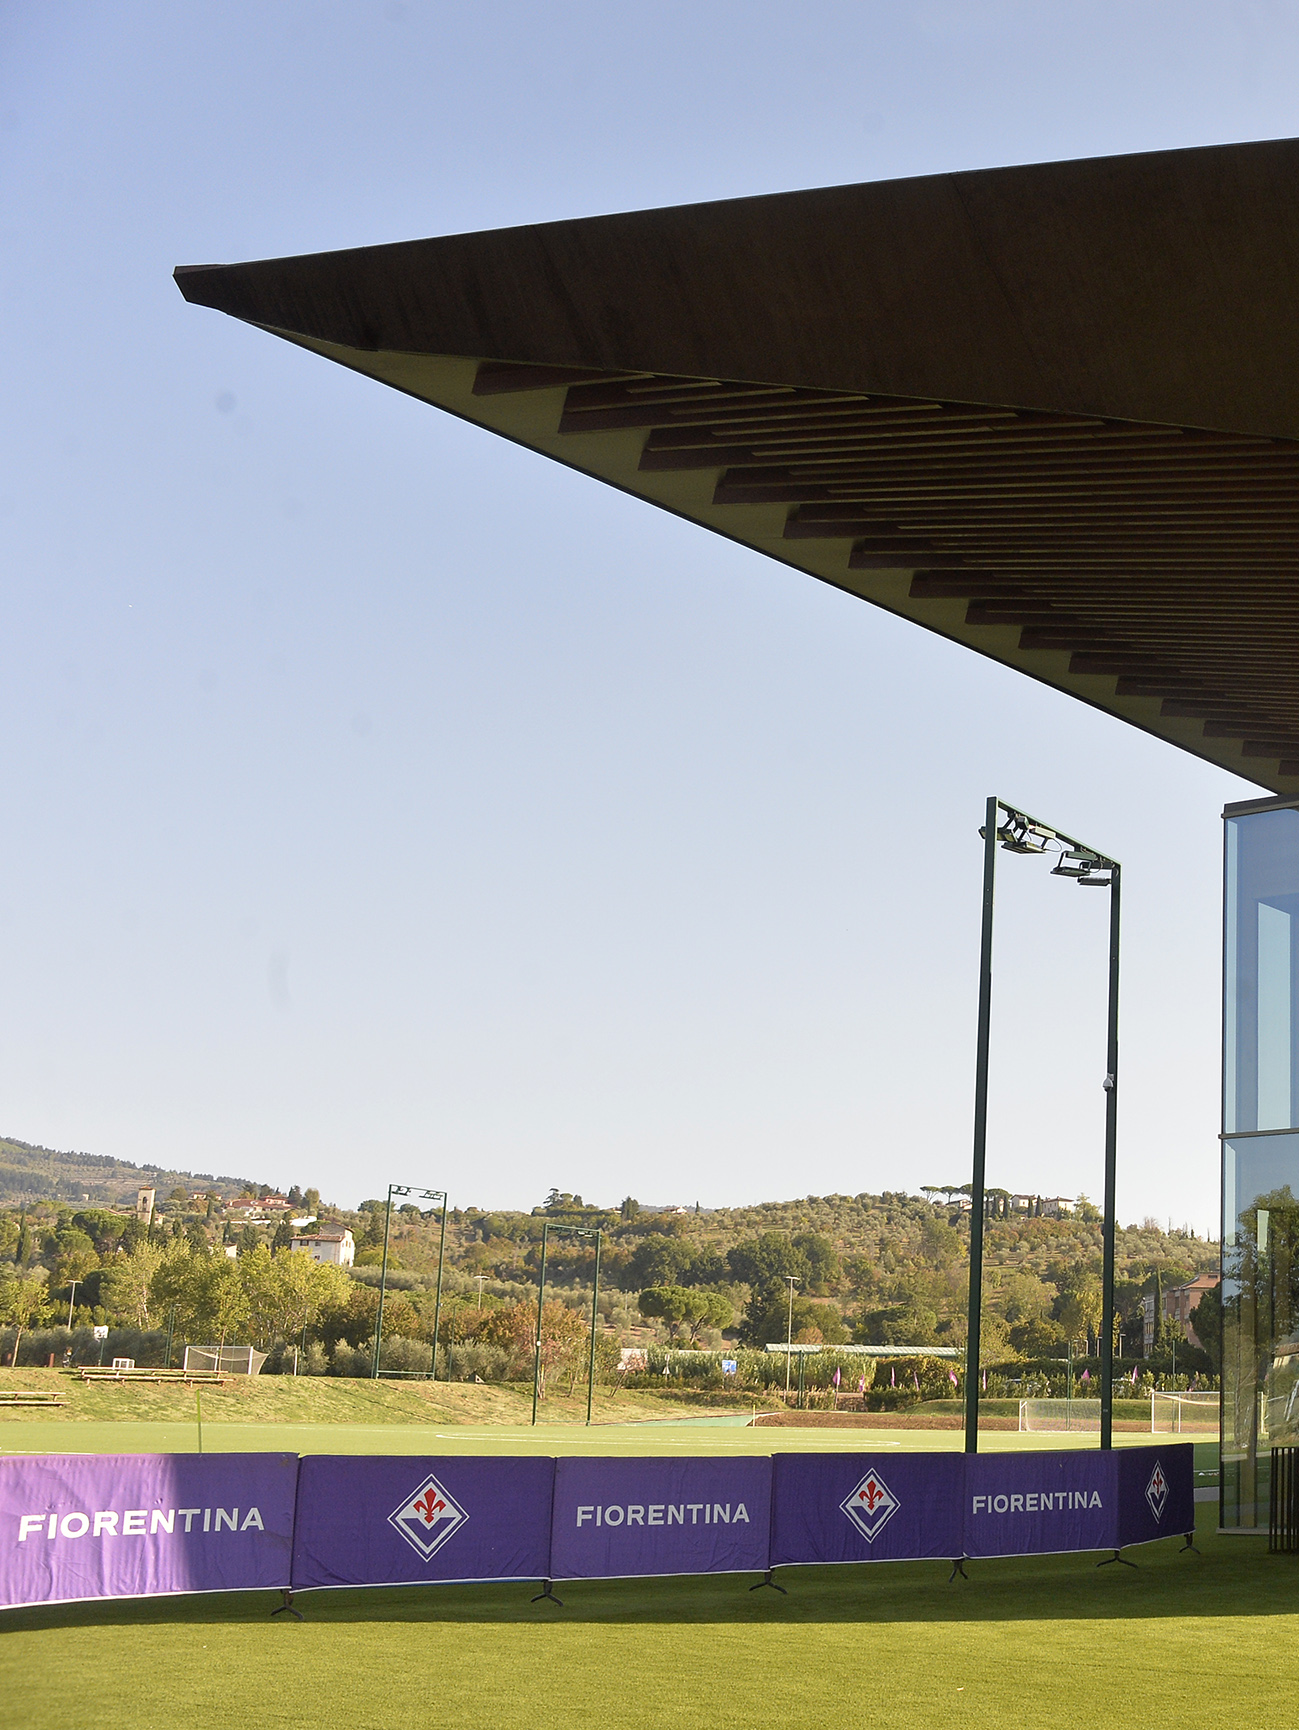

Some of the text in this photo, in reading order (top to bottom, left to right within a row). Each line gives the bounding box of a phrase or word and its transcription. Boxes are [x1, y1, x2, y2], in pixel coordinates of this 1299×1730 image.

[972, 1490, 1103, 1514] FIORENTINA
[18, 1508, 265, 1541] FIORENTINA
[577, 1503, 750, 1527] FIORENTINA
